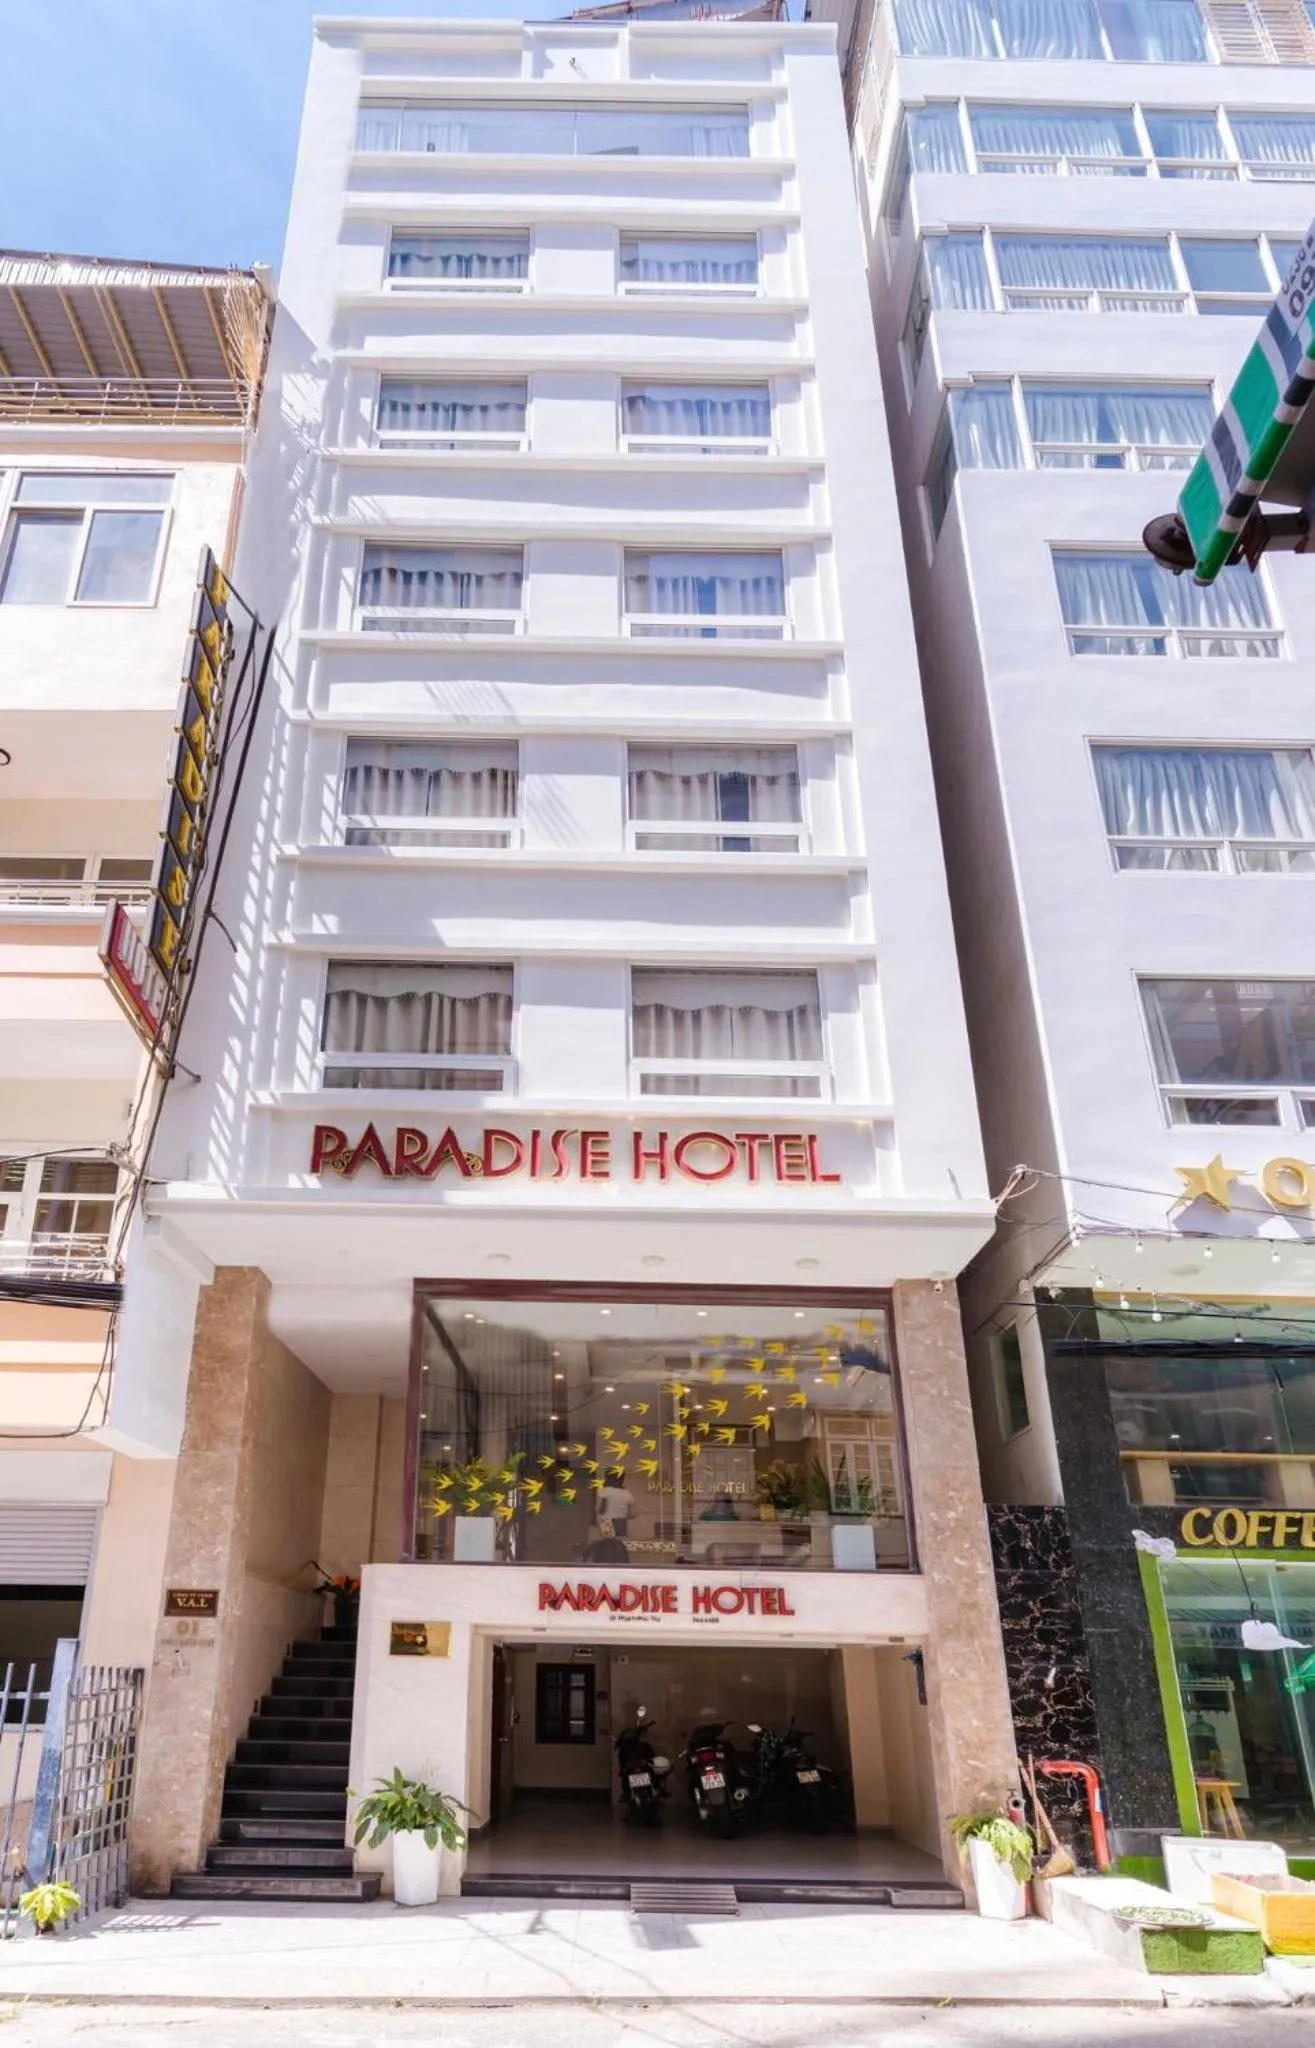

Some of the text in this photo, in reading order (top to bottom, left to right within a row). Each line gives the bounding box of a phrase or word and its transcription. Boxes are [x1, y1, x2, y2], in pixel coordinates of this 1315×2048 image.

[310, 1121, 843, 1185] PARADISE HOTEL
[538, 1582, 796, 1615] PARADISE HOTEL
